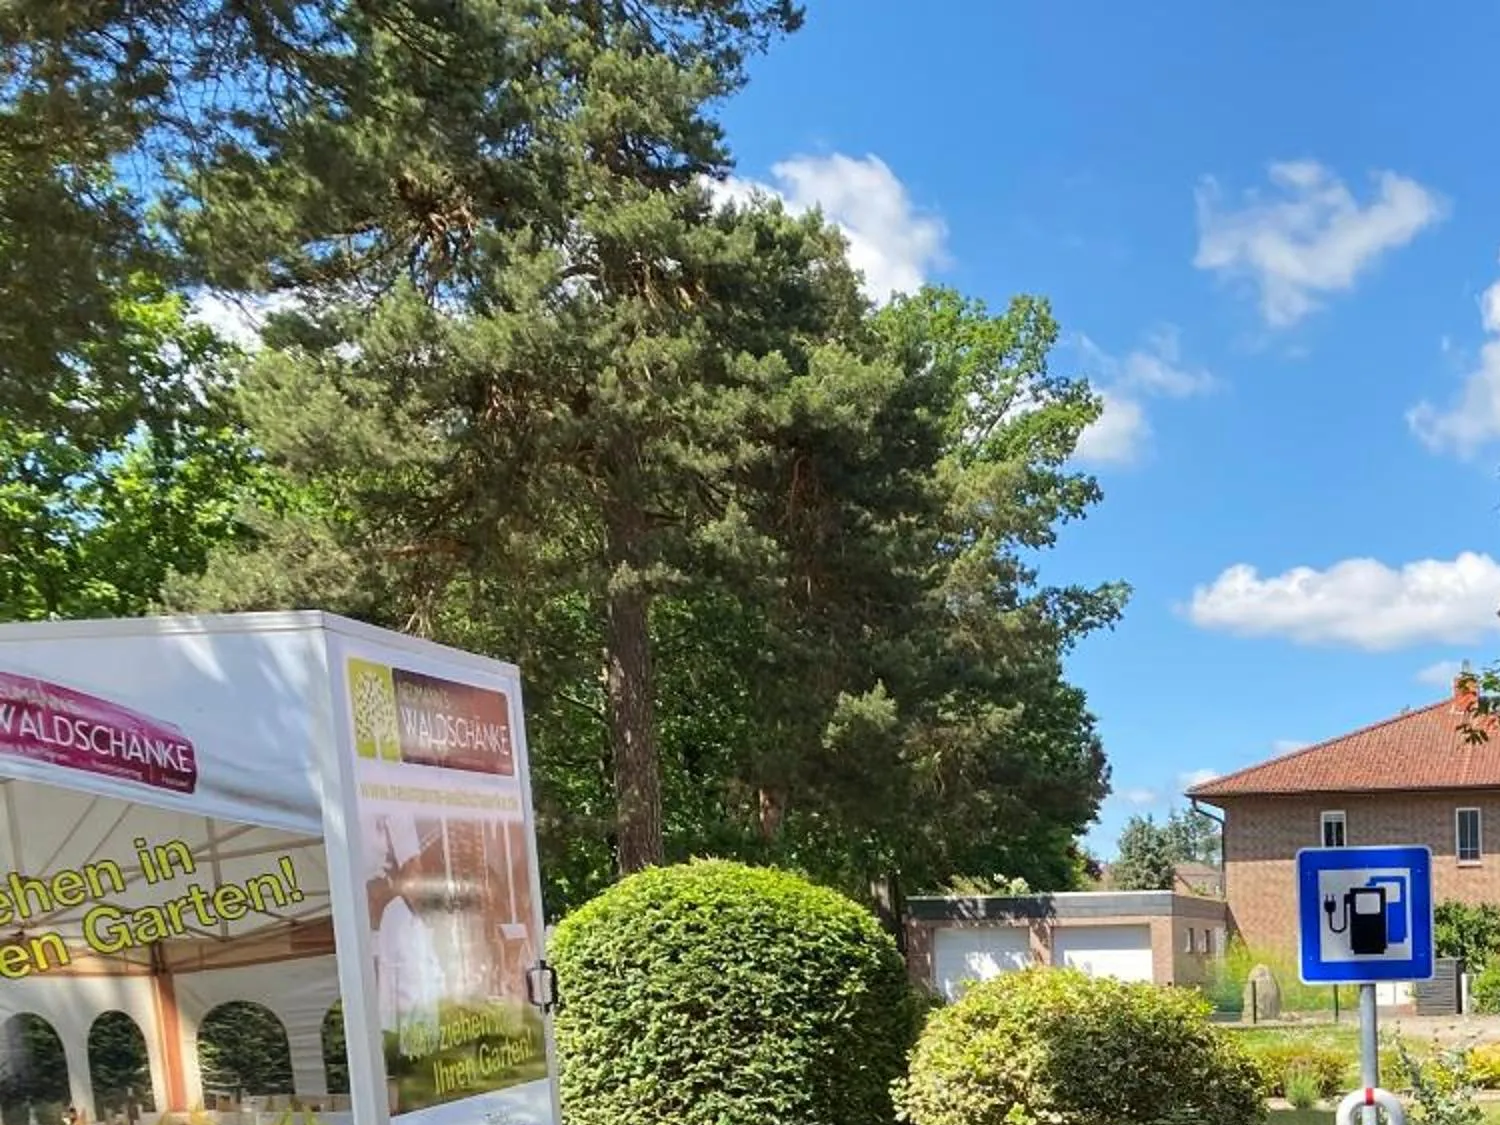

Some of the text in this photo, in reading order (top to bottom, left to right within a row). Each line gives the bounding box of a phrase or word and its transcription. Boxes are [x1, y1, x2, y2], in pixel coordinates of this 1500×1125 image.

[401, 706, 509, 756] WALDSCHÄNKE
[133, 837, 196, 885] in
[82, 856, 305, 954] Garten!
[433, 1056, 476, 1096] Ihren
[479, 1027, 534, 1076] Garten!
